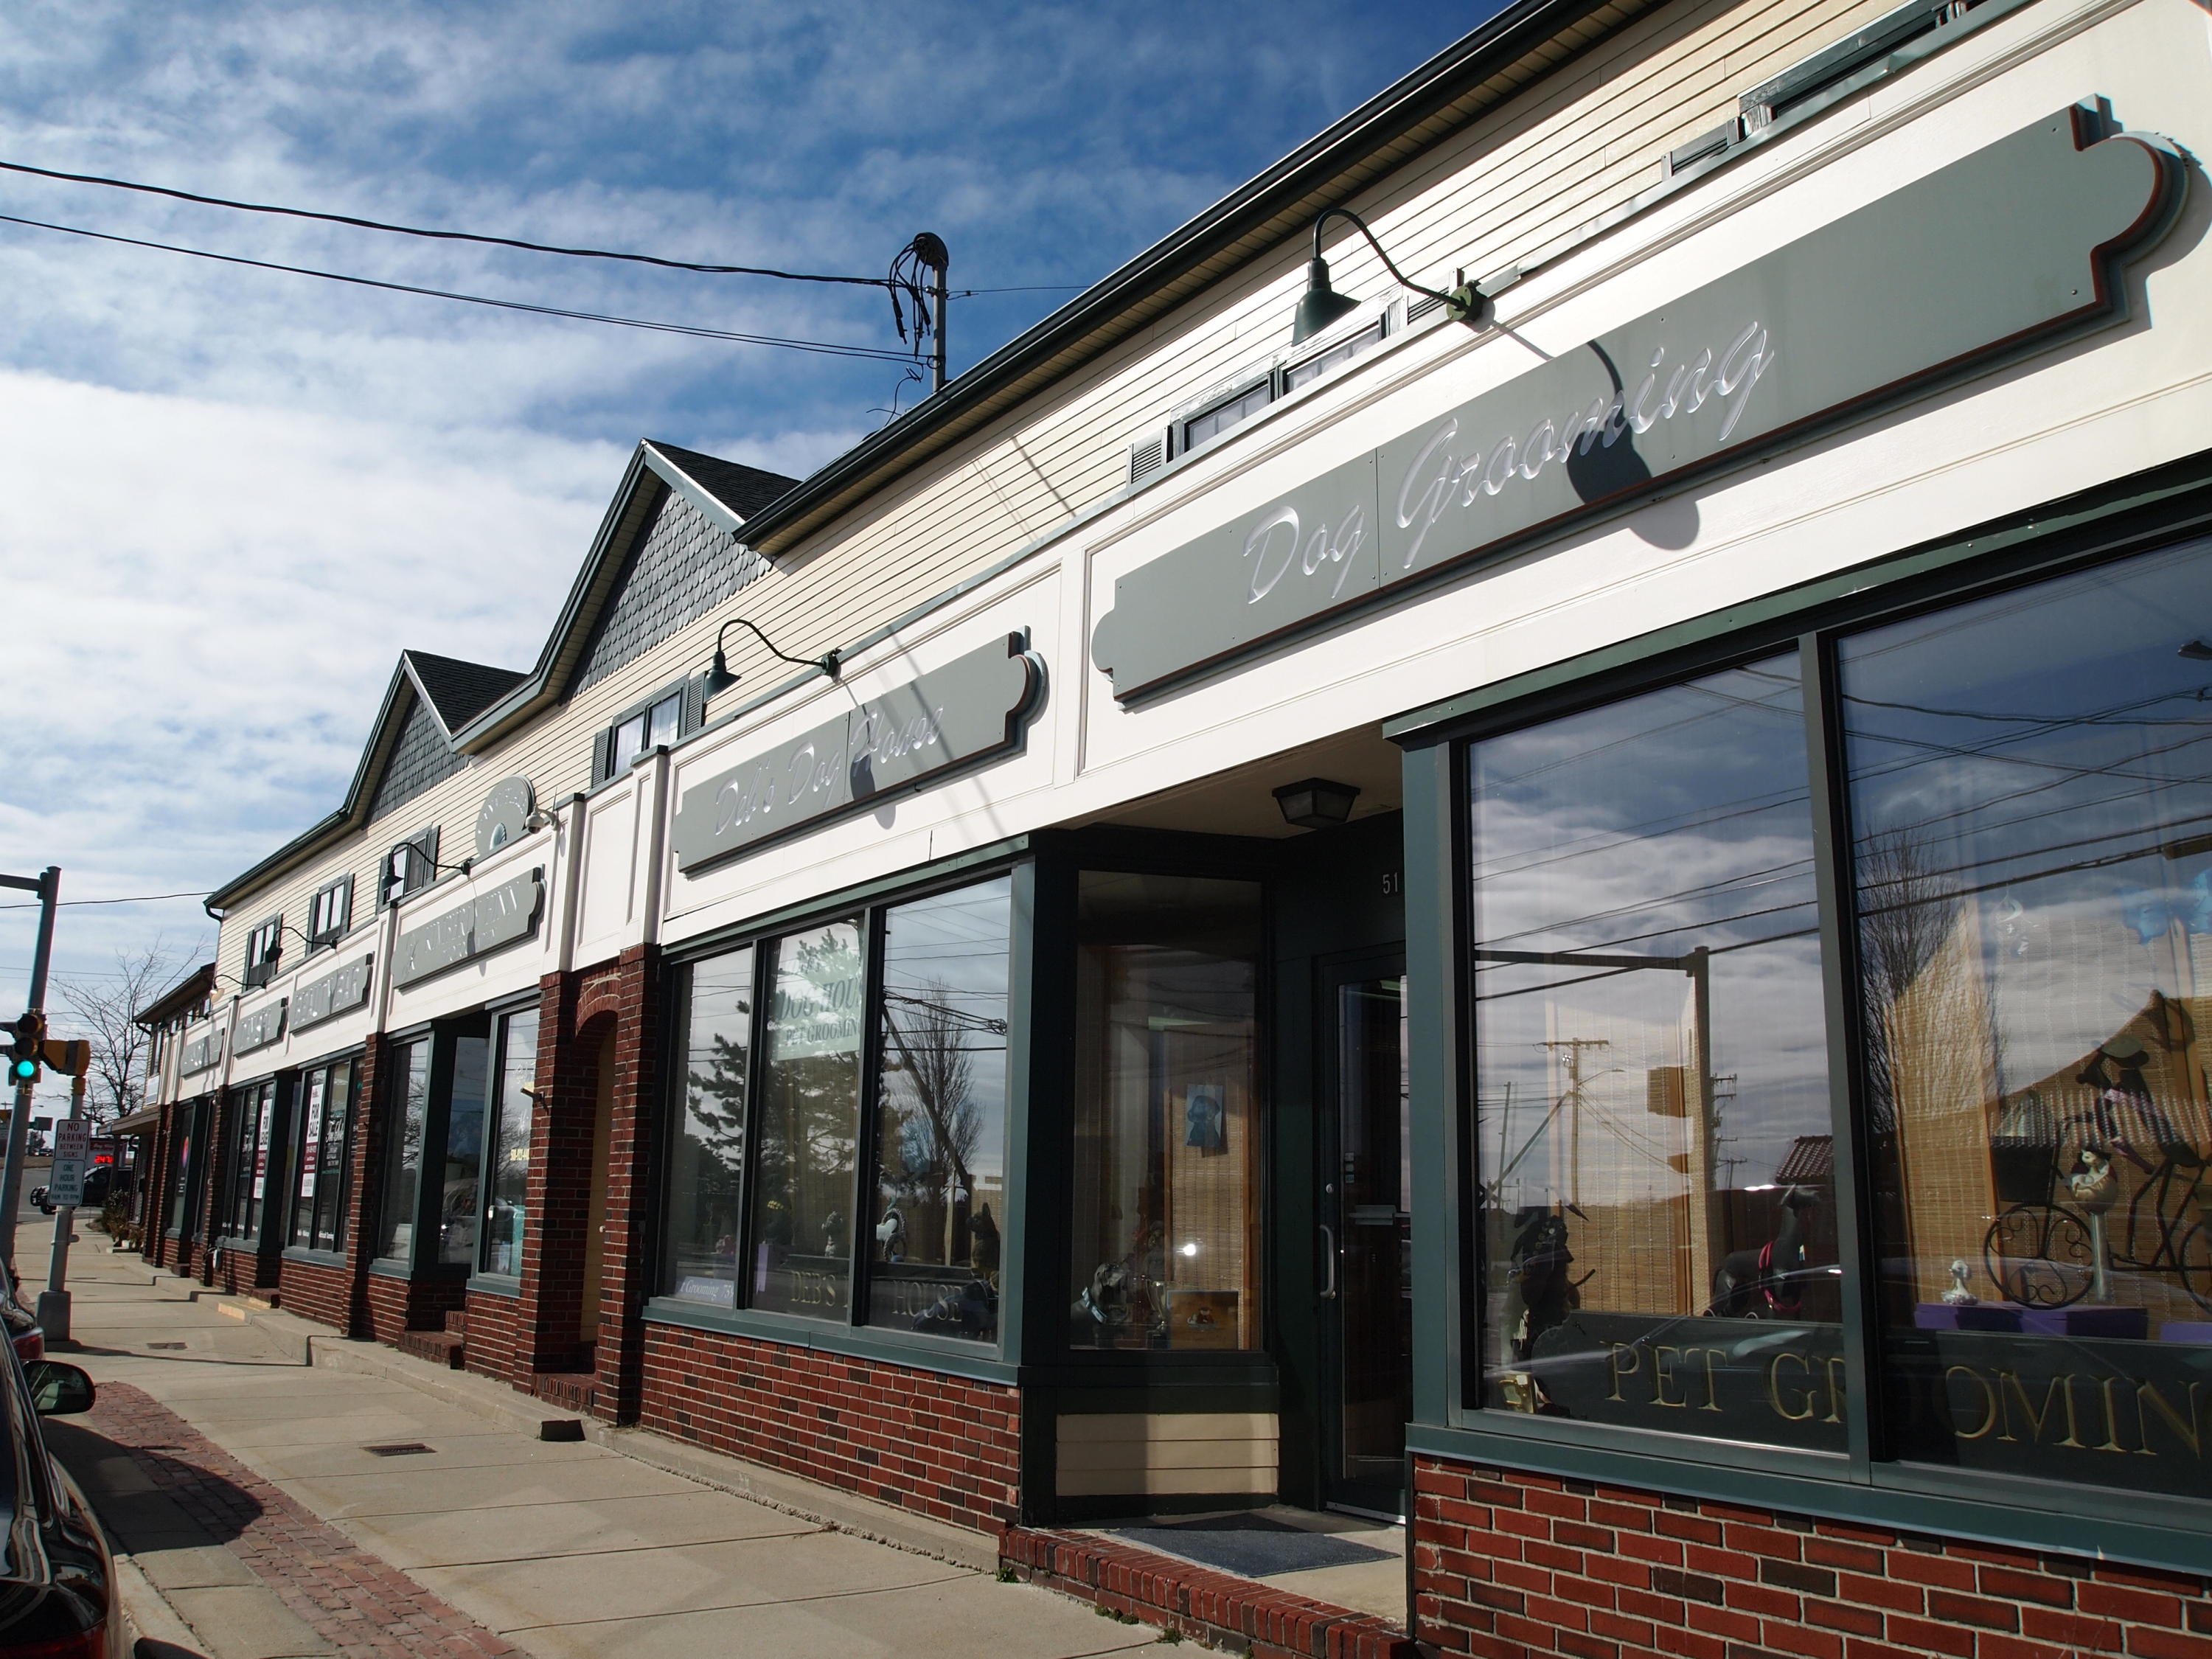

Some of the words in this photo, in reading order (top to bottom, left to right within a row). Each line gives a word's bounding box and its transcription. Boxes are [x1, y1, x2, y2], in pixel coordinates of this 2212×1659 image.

[1242, 504, 1368, 605] Dog
[1394, 320, 1776, 569] Grooming
[787, 740, 841, 811] Dog
[1382, 872, 1399, 894] 51
[807, 1018, 858, 1043] GROOMIN
[59, 1133, 86, 1142] PARKING
[67, 1122, 80, 1132] NO
[54, 1183, 78, 1192] PARKING
[685, 1279, 720, 1301] Grooming
[891, 1279, 964, 1322] HOUSE
[1599, 1340, 1729, 1412] PET
